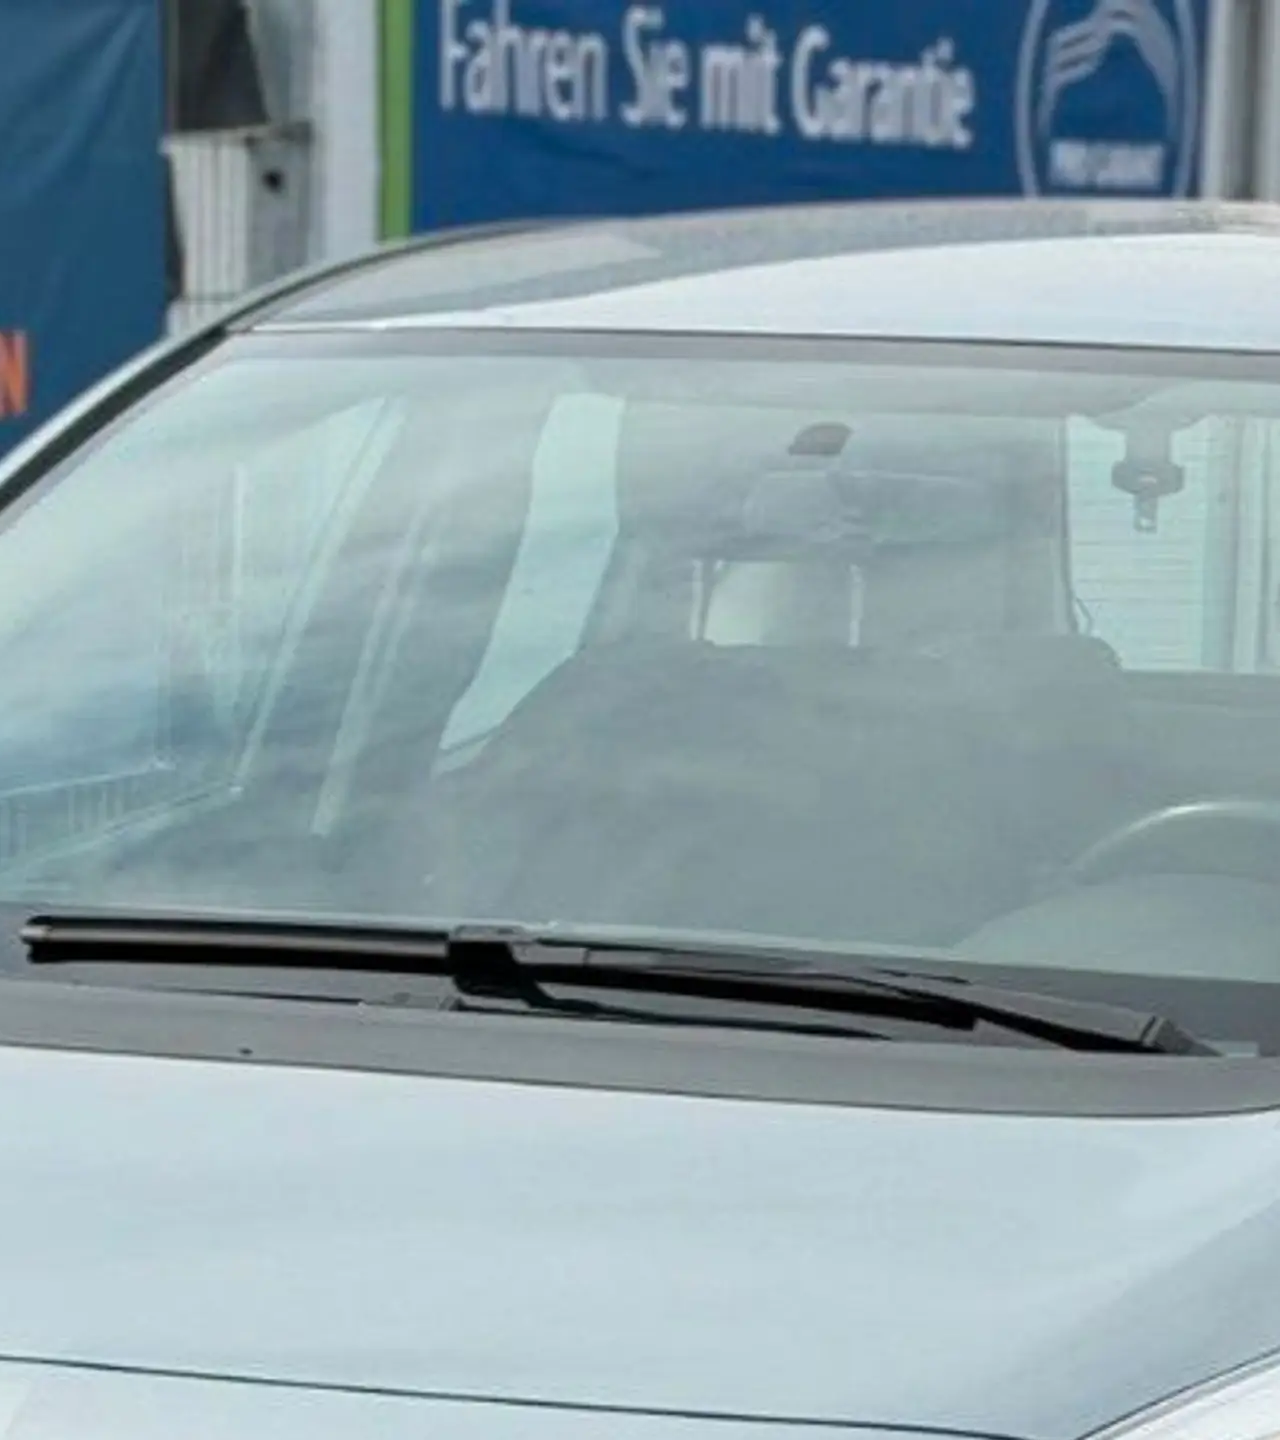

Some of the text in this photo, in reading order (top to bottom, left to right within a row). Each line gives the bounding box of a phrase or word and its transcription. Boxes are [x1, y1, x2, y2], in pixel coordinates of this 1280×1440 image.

[439, 0, 976, 150] Fahren Sie mit Garantie
